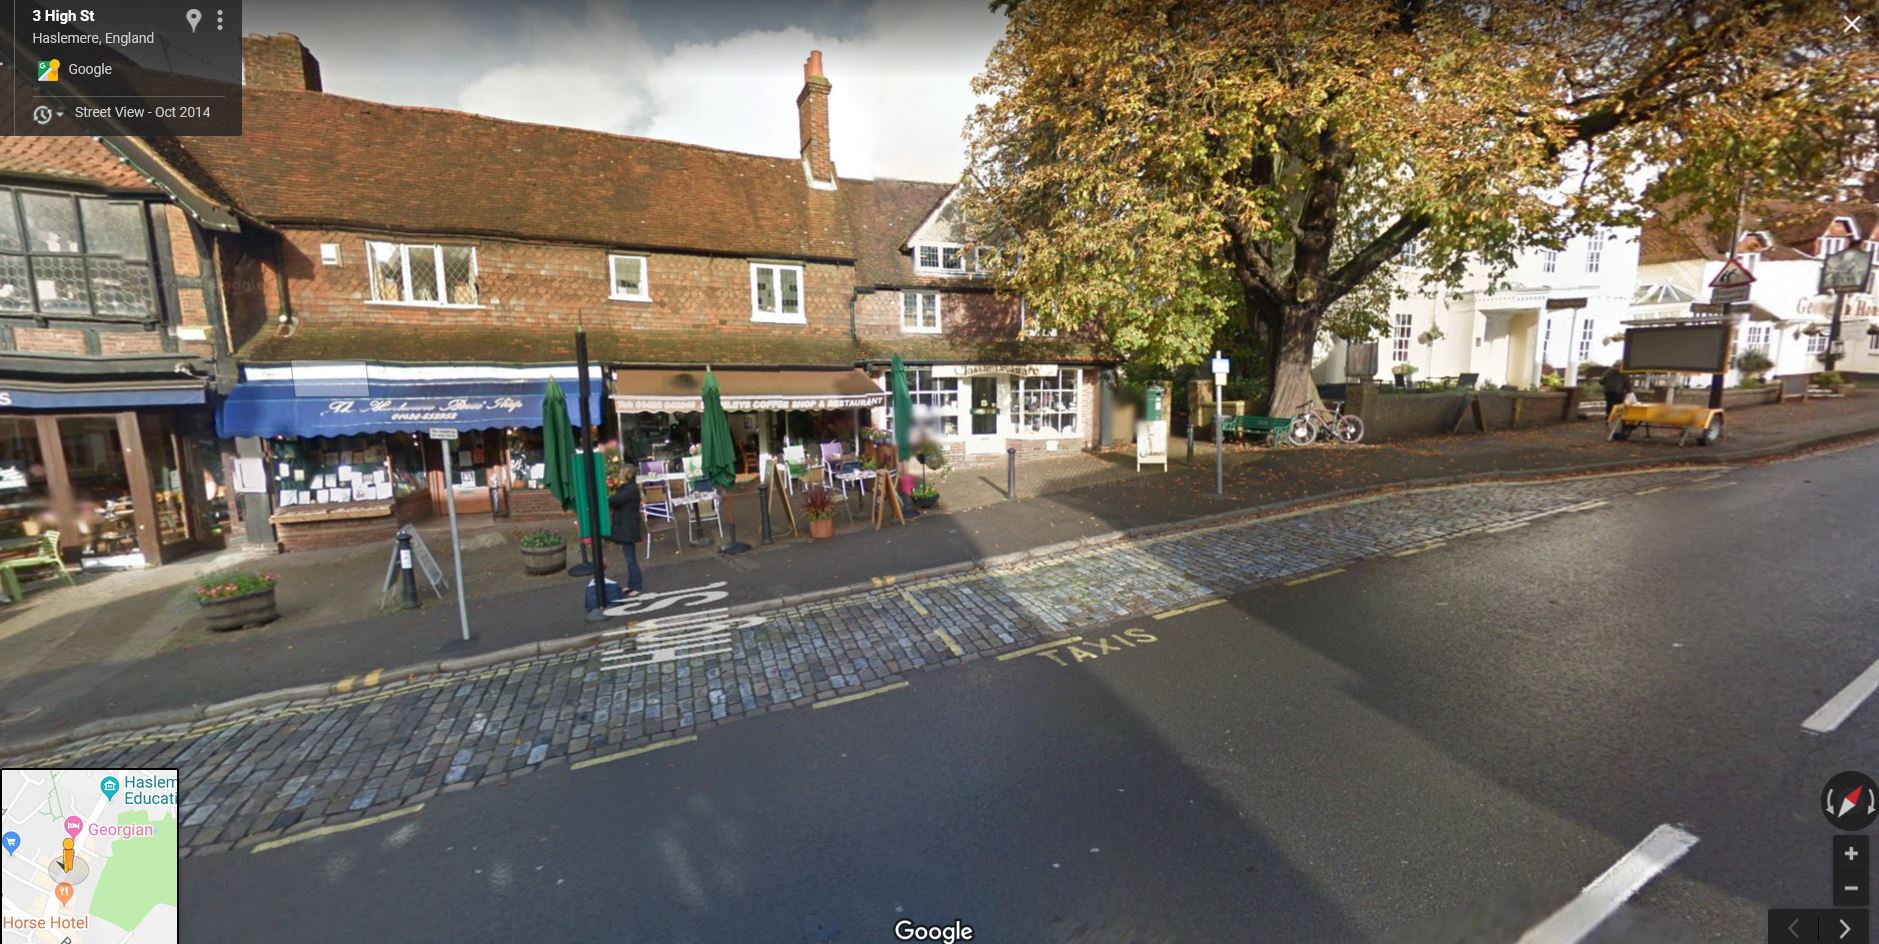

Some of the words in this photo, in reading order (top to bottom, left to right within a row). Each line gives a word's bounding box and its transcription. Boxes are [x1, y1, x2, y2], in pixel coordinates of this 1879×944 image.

[753, 400, 789, 410] COFFEE
[792, 399, 816, 409] SHOP
[827, 397, 884, 409] RESTAURANT
[1036, 628, 1158, 667] TAXIS
